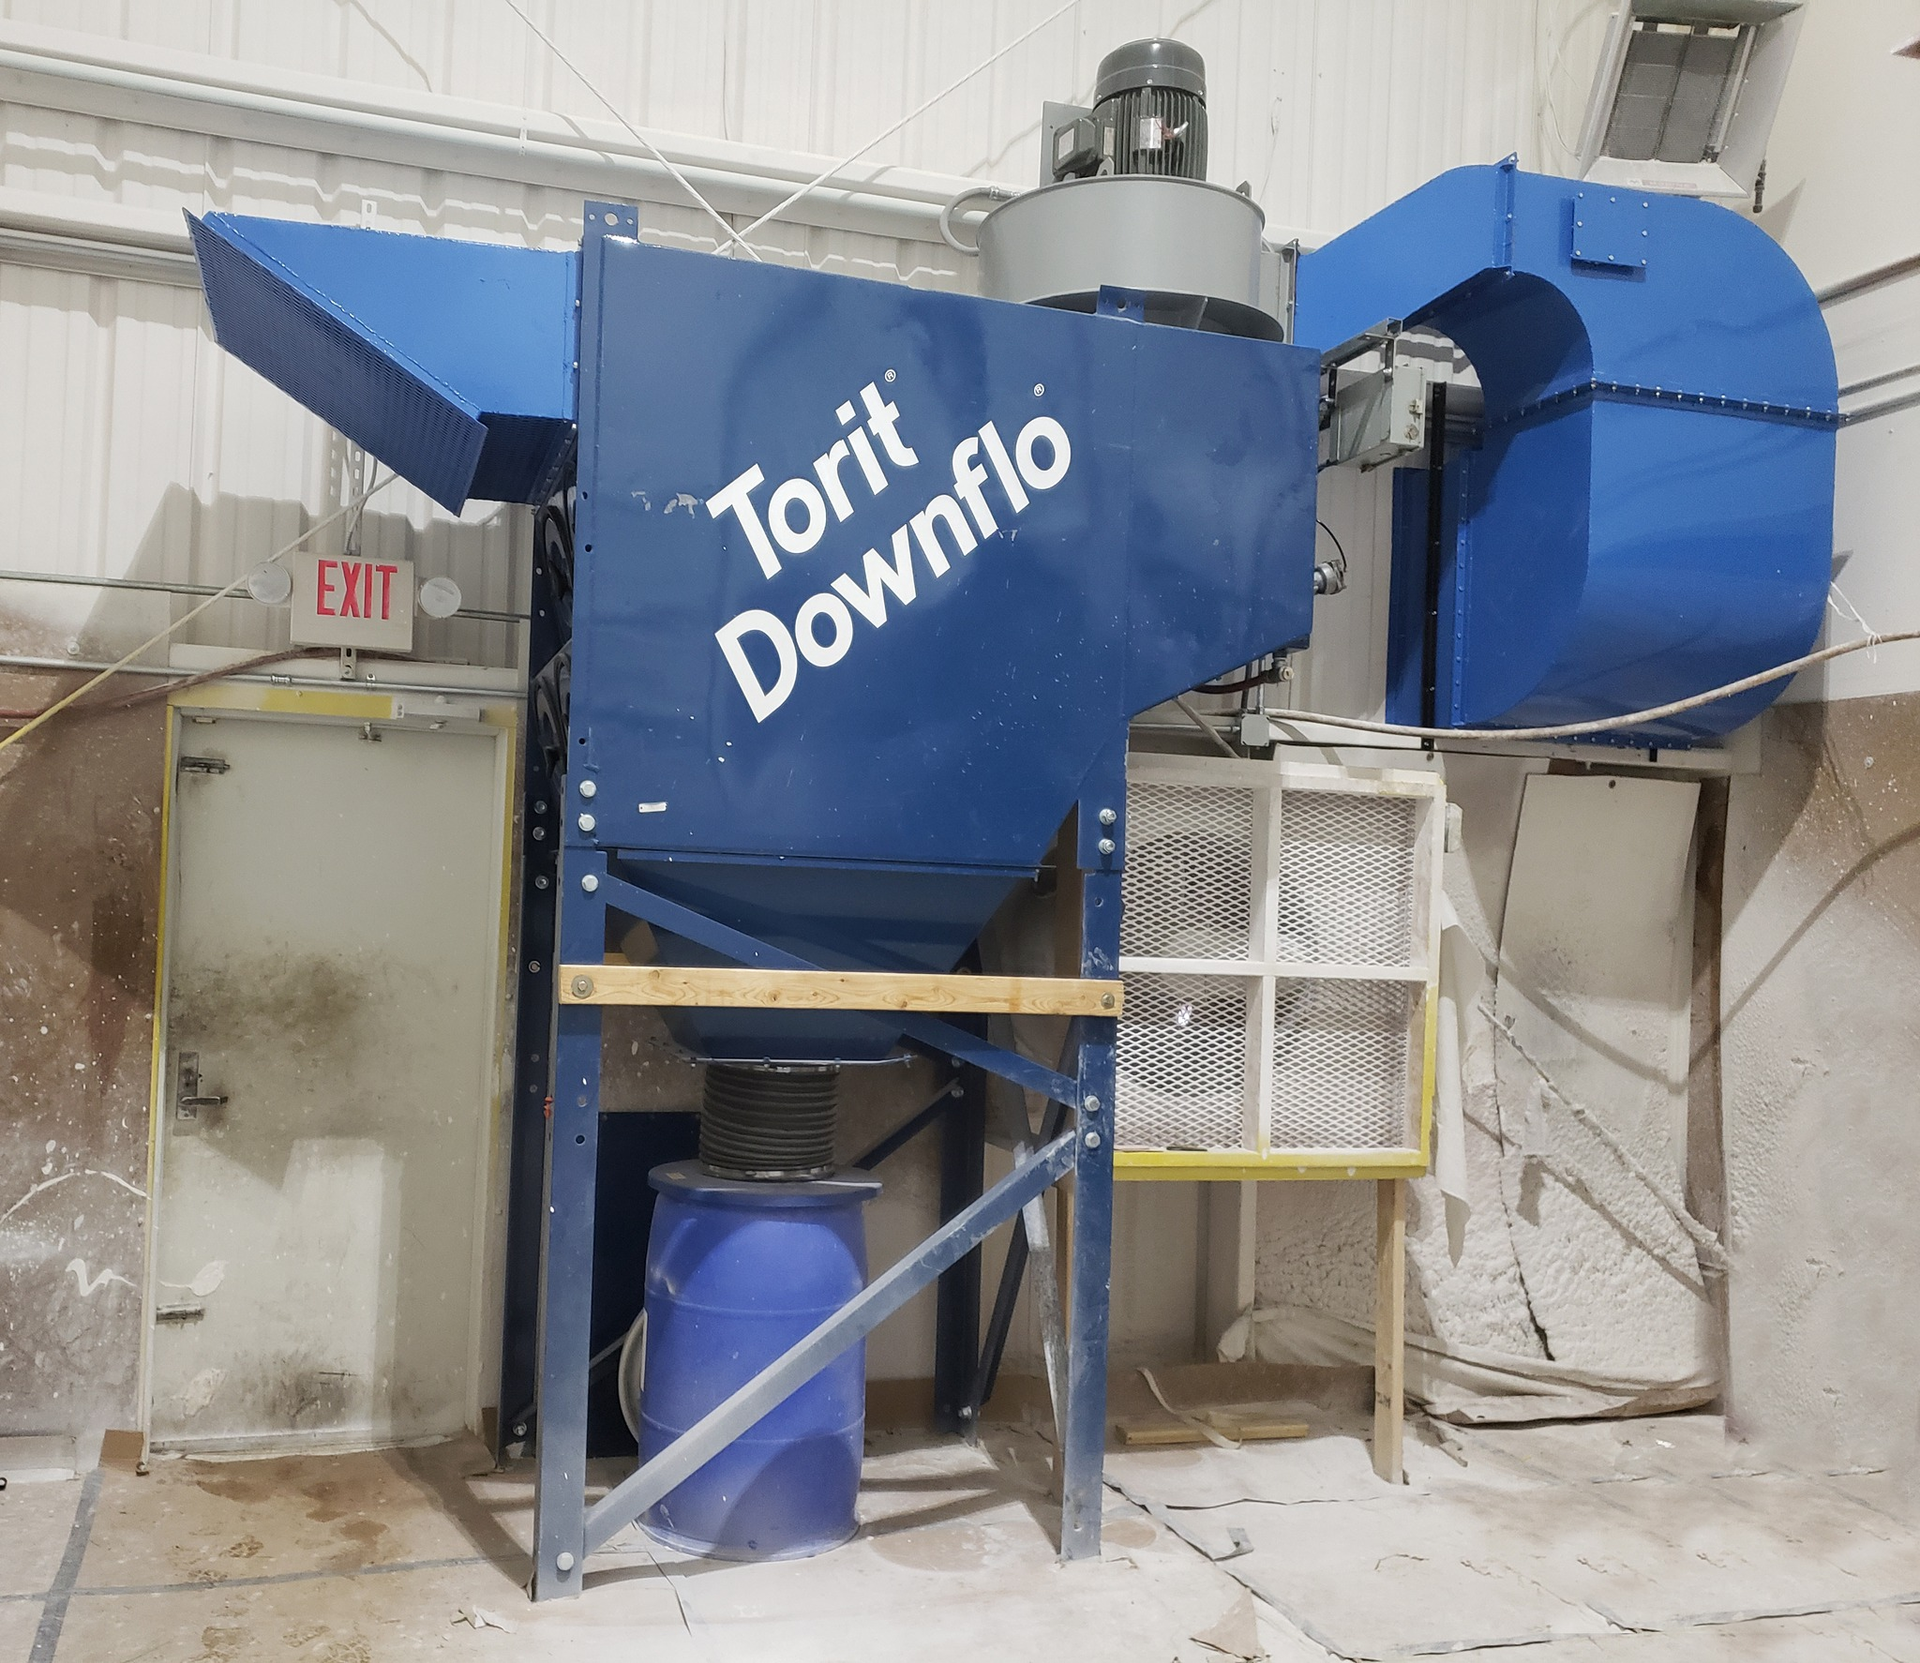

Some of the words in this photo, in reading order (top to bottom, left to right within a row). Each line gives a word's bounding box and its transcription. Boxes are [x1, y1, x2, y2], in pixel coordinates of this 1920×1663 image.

[706, 382, 919, 579] Torit
[715, 417, 1071, 723] Downflo
[317, 559, 398, 619] EXIT
